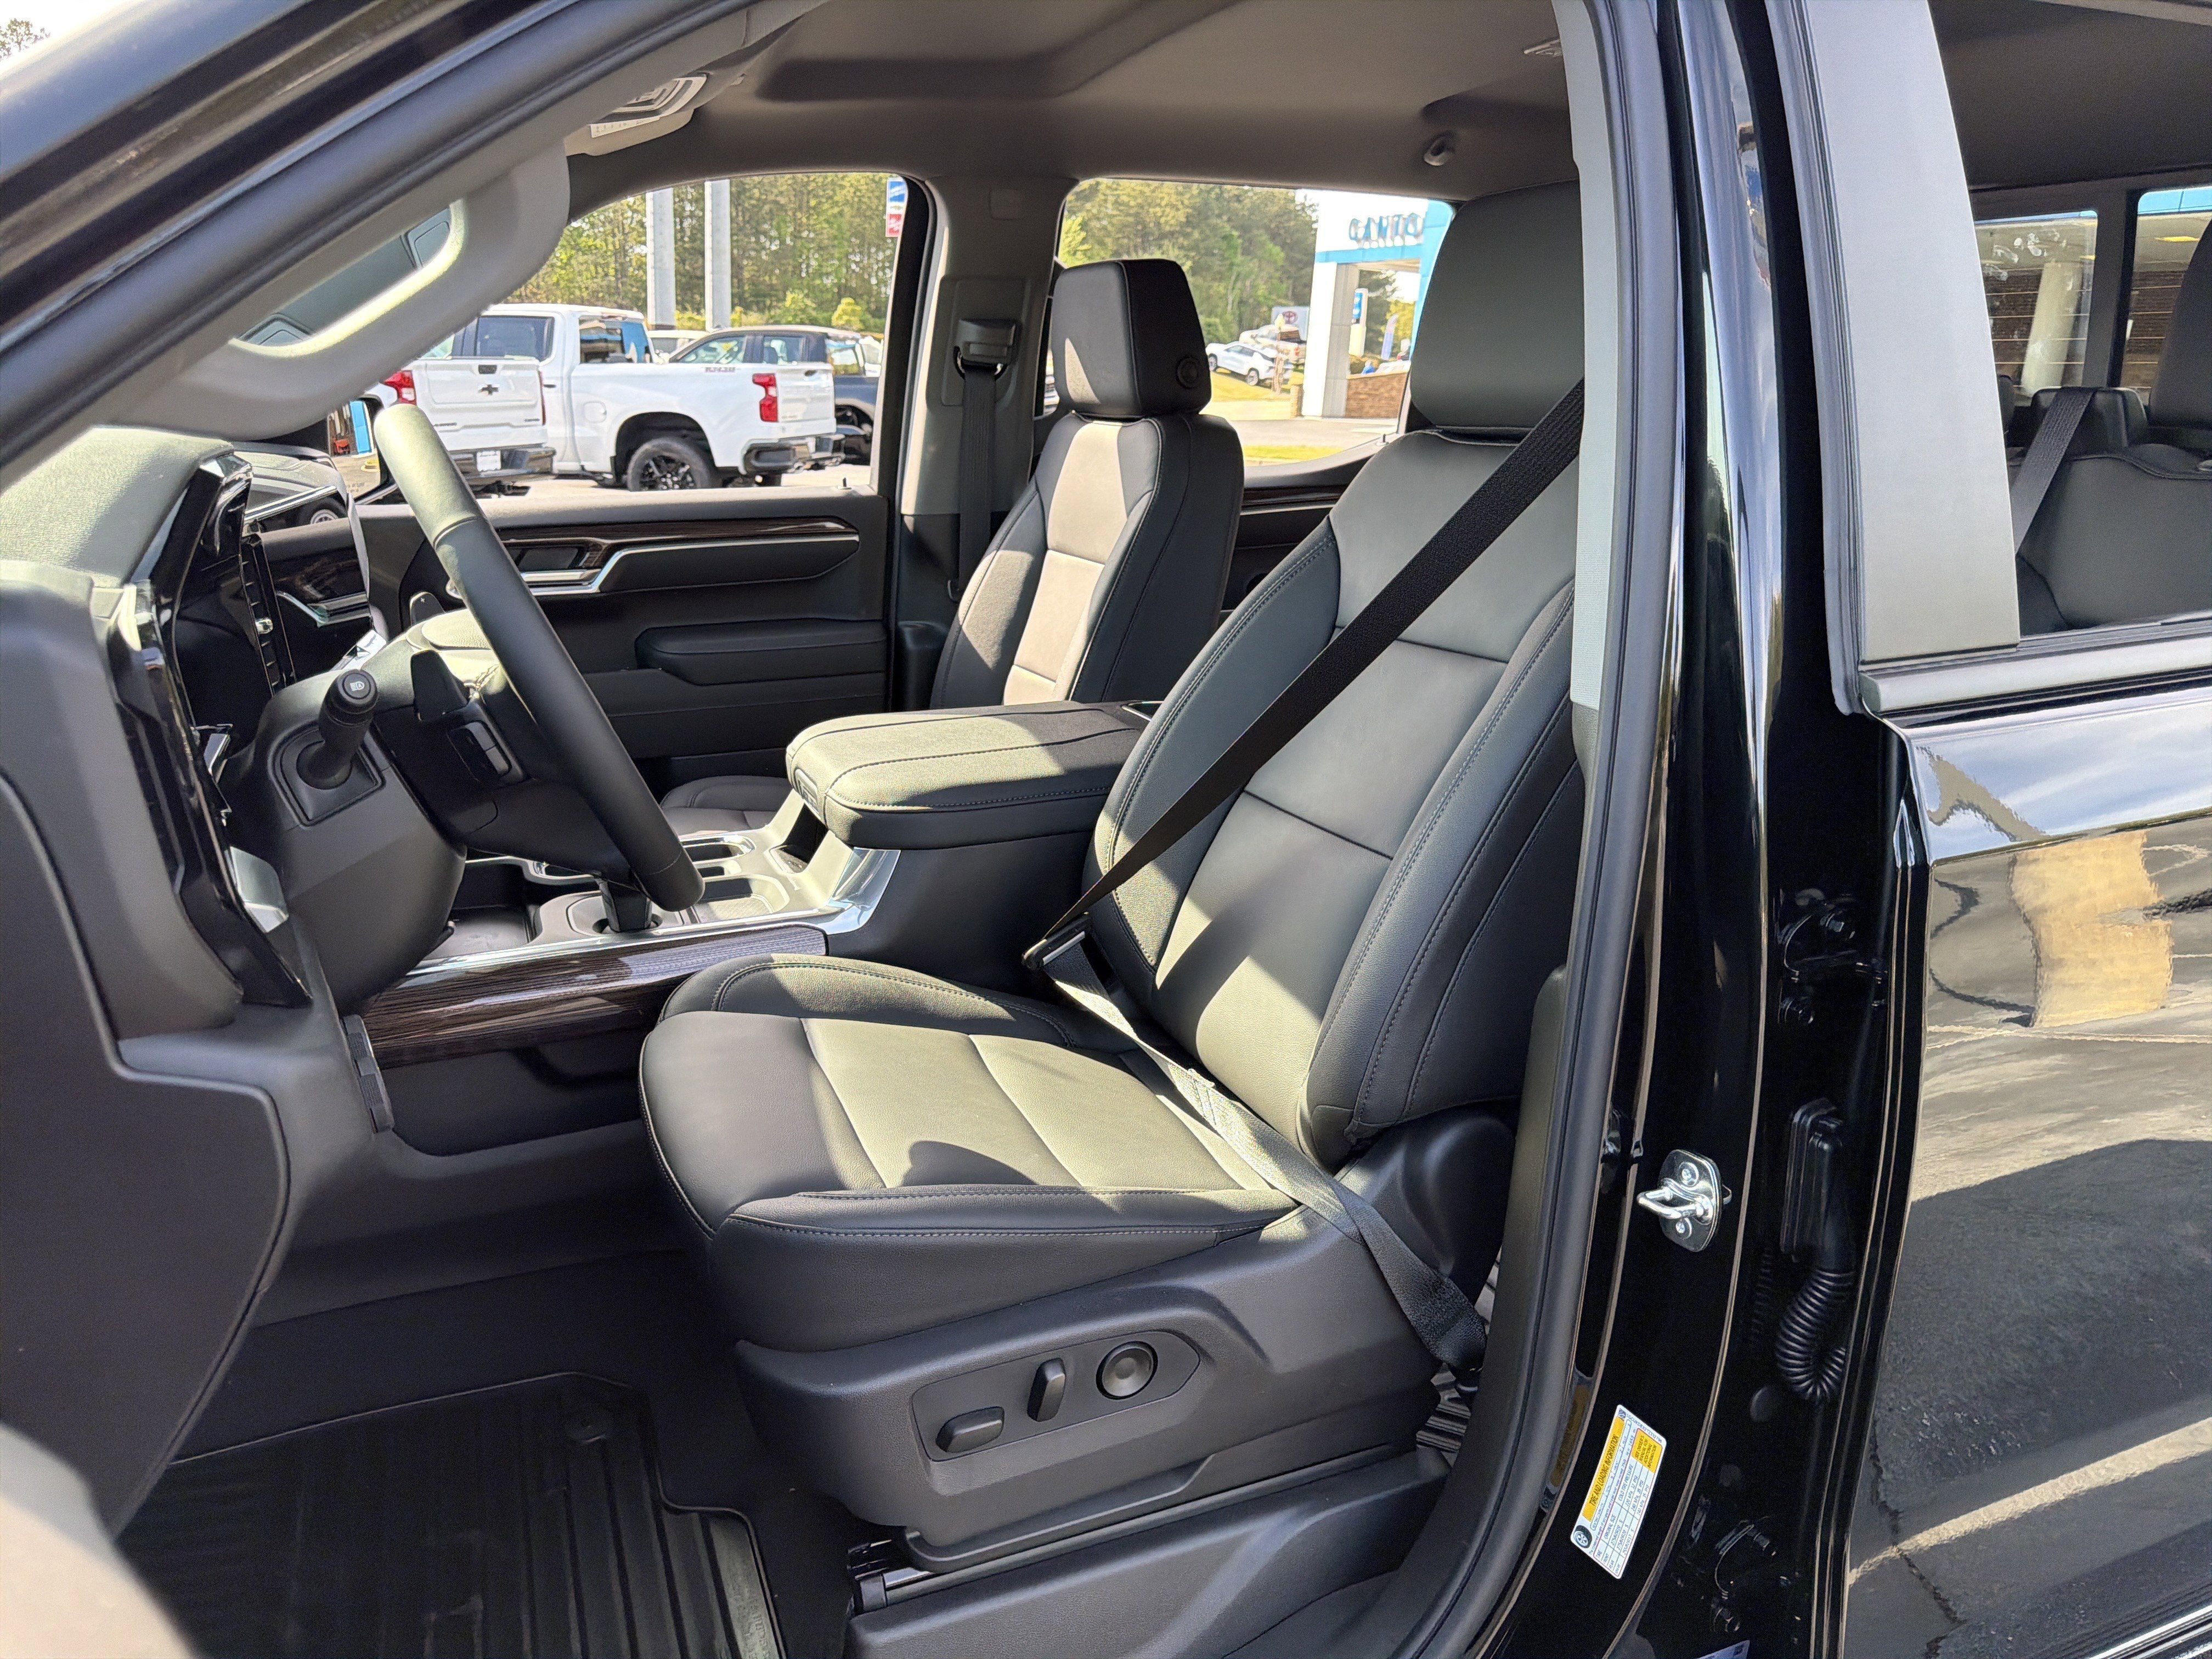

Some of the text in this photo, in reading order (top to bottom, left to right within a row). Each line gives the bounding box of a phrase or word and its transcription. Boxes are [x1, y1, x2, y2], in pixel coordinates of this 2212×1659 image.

[1589, 1433, 1620, 1507] TIRE AND LOADING INFORMATION
[1624, 1463, 1634, 1483] PRESSURE
